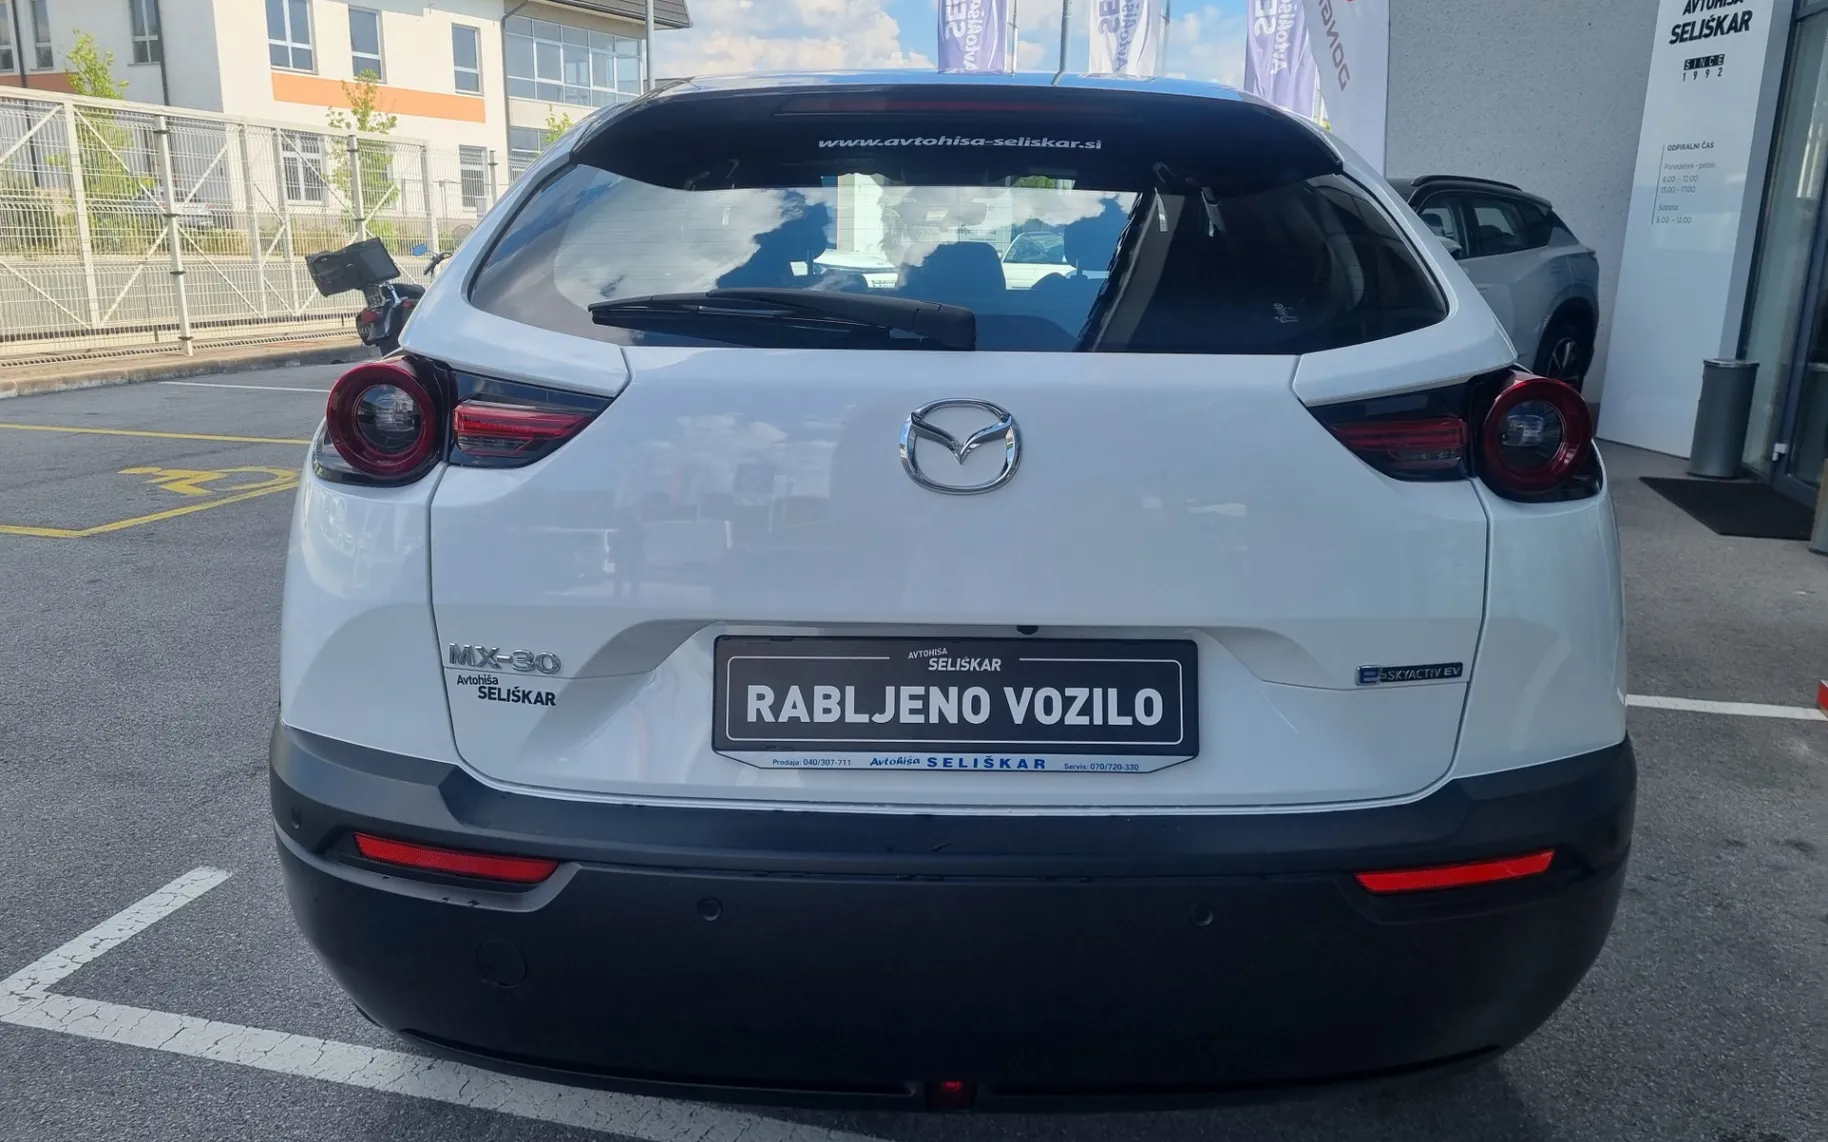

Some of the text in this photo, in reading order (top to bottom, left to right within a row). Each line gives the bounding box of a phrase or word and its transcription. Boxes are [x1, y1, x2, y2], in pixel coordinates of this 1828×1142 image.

[1668, 9, 1753, 45] SELIŠKAR
[1684, 54, 1724, 70] SINCE
[818, 135, 1102, 150] www.avtohisa-seliskar.si
[449, 642, 562, 675] MX-30
[928, 656, 1002, 672] SELIŠKAR
[456, 674, 499, 685] Avtohiša
[478, 686, 556, 706] SELIŠKAR
[746, 685, 1163, 726] RABLJENO VOZILO
[772, 758, 851, 767] Prodaja: 040/307-711
[870, 755, 1046, 770] Avtohiša SELIŠKAR
